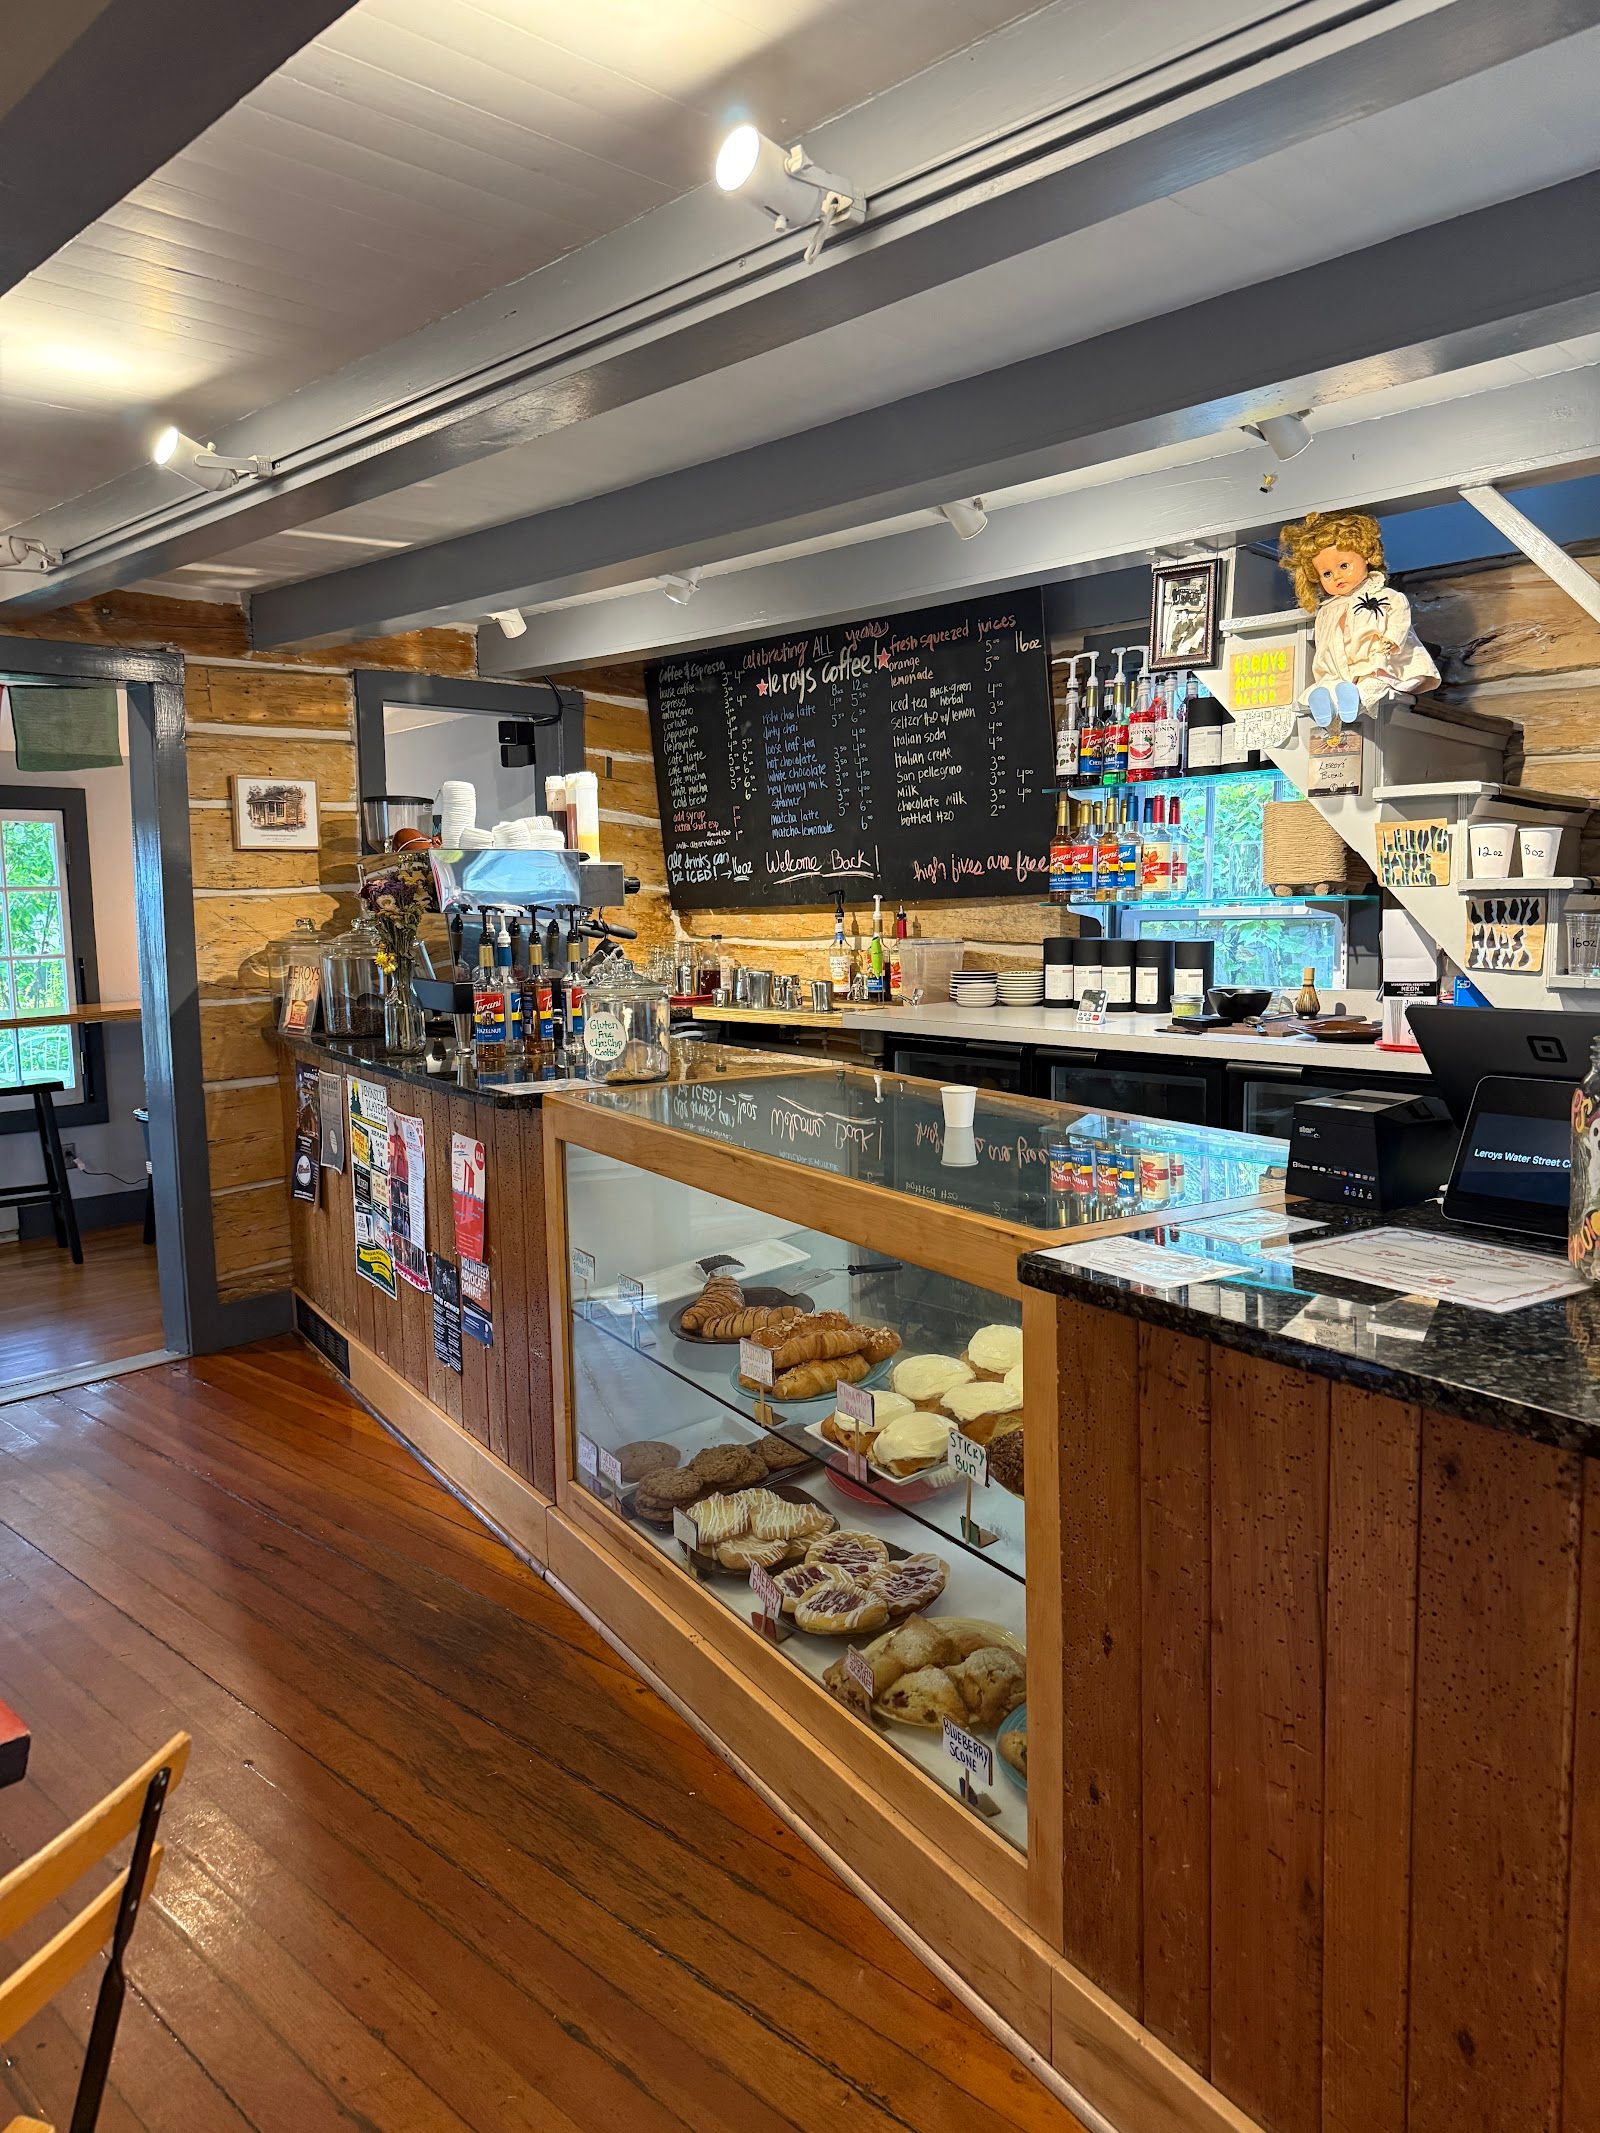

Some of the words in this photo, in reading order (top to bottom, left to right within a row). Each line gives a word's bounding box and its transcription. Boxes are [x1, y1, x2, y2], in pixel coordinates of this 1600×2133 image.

[890, 635, 917, 656] fresh
[920, 619, 969, 652] squeezed
[977, 614, 1016, 642] juices
[742, 640, 808, 670] celebrating
[813, 634, 834, 658] ALL
[889, 656, 920, 673] orange
[768, 667, 817, 704] leroys
[891, 667, 934, 688] lemonade
[677, 681, 695, 695] coffee
[661, 698, 686, 713] espresso
[911, 697, 927, 711] tea
[940, 693, 964, 706] herbal
[796, 704, 816, 718] latte
[952, 707, 976, 721] lemon
[763, 726, 780, 742] dirty
[783, 722, 798, 734] chai
[893, 734, 921, 747] Italian
[924, 727, 946, 743] soda
[765, 743, 782, 756] loose
[785, 736, 800, 752] leaf
[802, 738, 816, 752] tea
[686, 751, 706, 764] latte
[766, 758, 779, 769] hot
[780, 753, 817, 767] chocolate
[895, 751, 924, 768] Italian
[768, 770, 786, 782] white
[788, 764, 826, 778] chocolate
[918, 765, 962, 783] pellegrino
[784, 782, 806, 798] honey
[673, 798, 687, 809] cold
[689, 795, 707, 806] brew
[898, 797, 939, 811] chocolate
[673, 810, 684, 822] add
[686, 810, 706, 824] syrup
[771, 810, 797, 825] matcha
[800, 809, 819, 821] latte
[900, 812, 931, 826] bottled
[937, 810, 954, 823] H2O
[692, 822, 707, 831] shot
[708, 821, 719, 831] esp
[772, 826, 801, 839] matcha
[802, 821, 835, 836] lemonade
[684, 853, 711, 869] drinks
[713, 852, 730, 865] can
[766, 850, 822, 873] Welcome
[913, 856, 946, 884] high
[952, 854, 985, 882] fives
[987, 855, 1012, 870] are
[1017, 851, 1050, 882] free
[672, 871, 684, 885] be
[1470, 898, 1540, 926] LEROYS
[474, 998, 502, 1014] Torani
[590, 1020, 618, 1030] Gluten
[1474, 1148, 1503, 1160] Leroys
[1504, 1152, 1531, 1163] Water
[1532, 1156, 1560, 1167] Street
[461, 1257, 490, 1280] VOLUNTEER
[461, 1268, 486, 1292] ADVOCATE
[950, 1432, 984, 1466] STICKY
[943, 1718, 988, 1769] BLUEBERRY
[950, 1741, 977, 1772] SCONE
